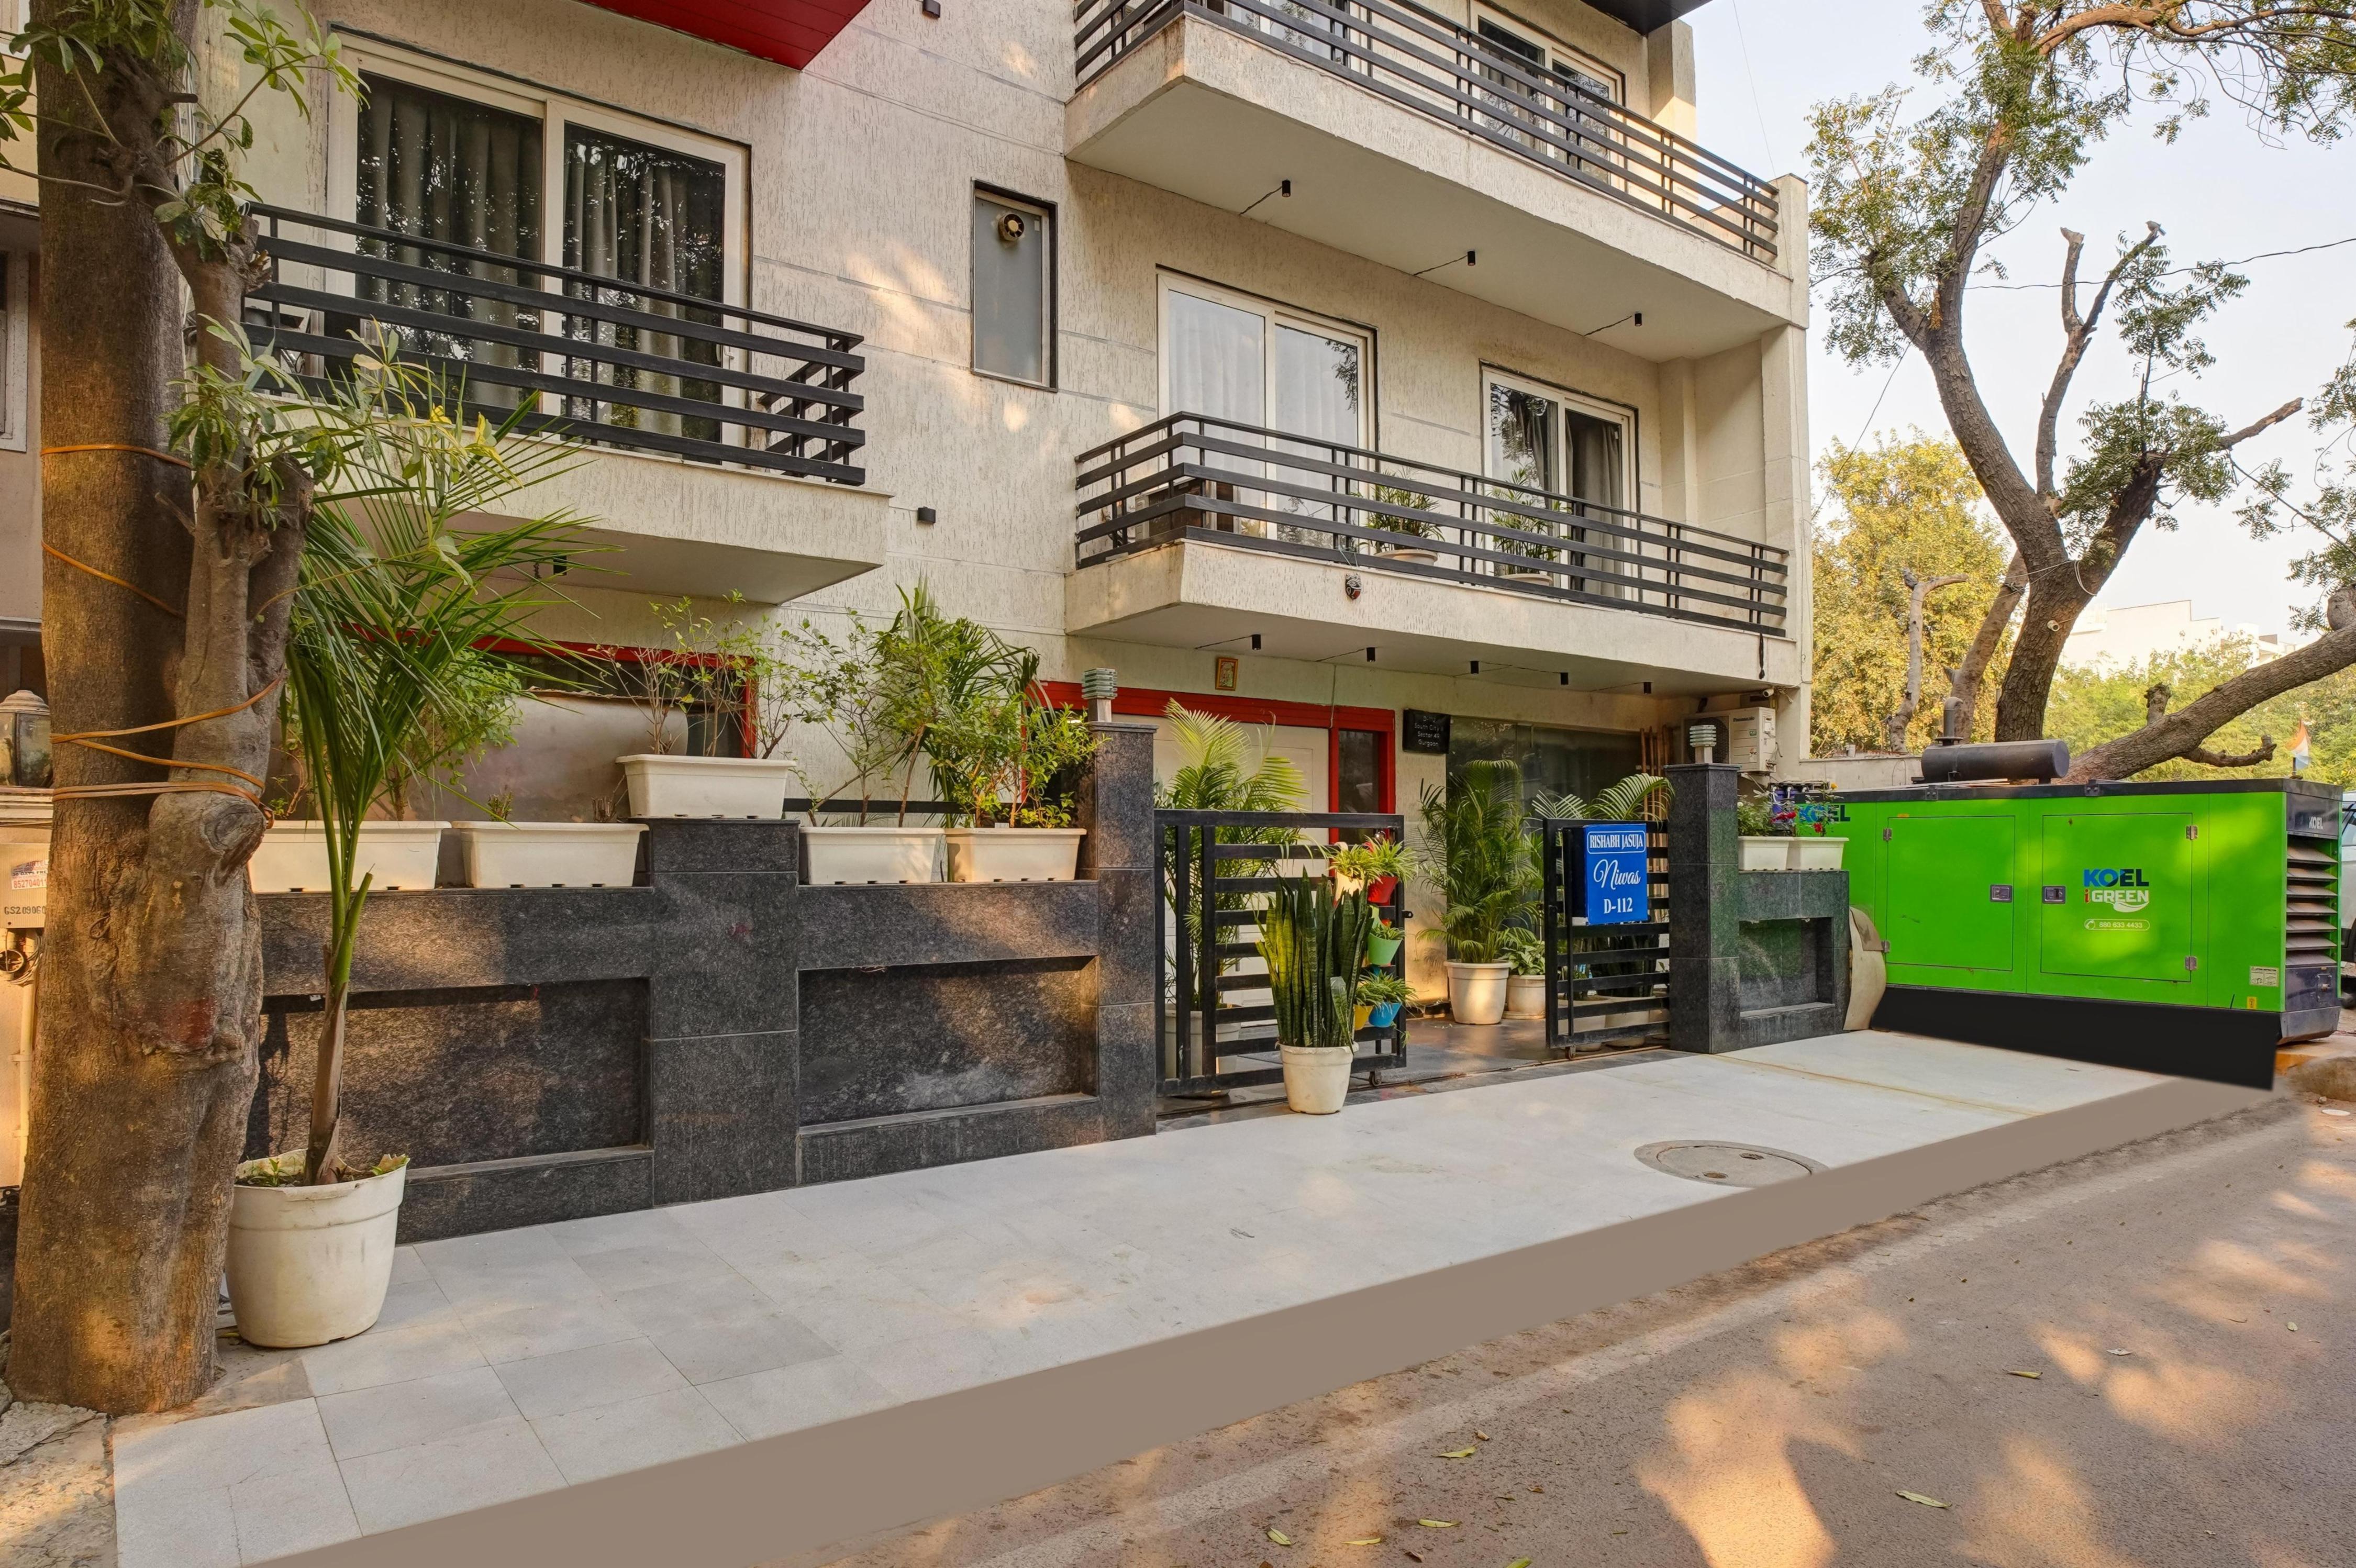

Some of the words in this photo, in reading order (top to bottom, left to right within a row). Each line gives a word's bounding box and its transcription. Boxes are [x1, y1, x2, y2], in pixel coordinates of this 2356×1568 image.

[2309, 816, 2324, 830] KOEL
[1590, 835, 1620, 848] RISHABH
[1621, 834, 1643, 850] JASUJA
[1593, 859, 1641, 890] Niwas
[2083, 869, 2149, 887] KOEL
[1604, 897, 1633, 914] D-112
